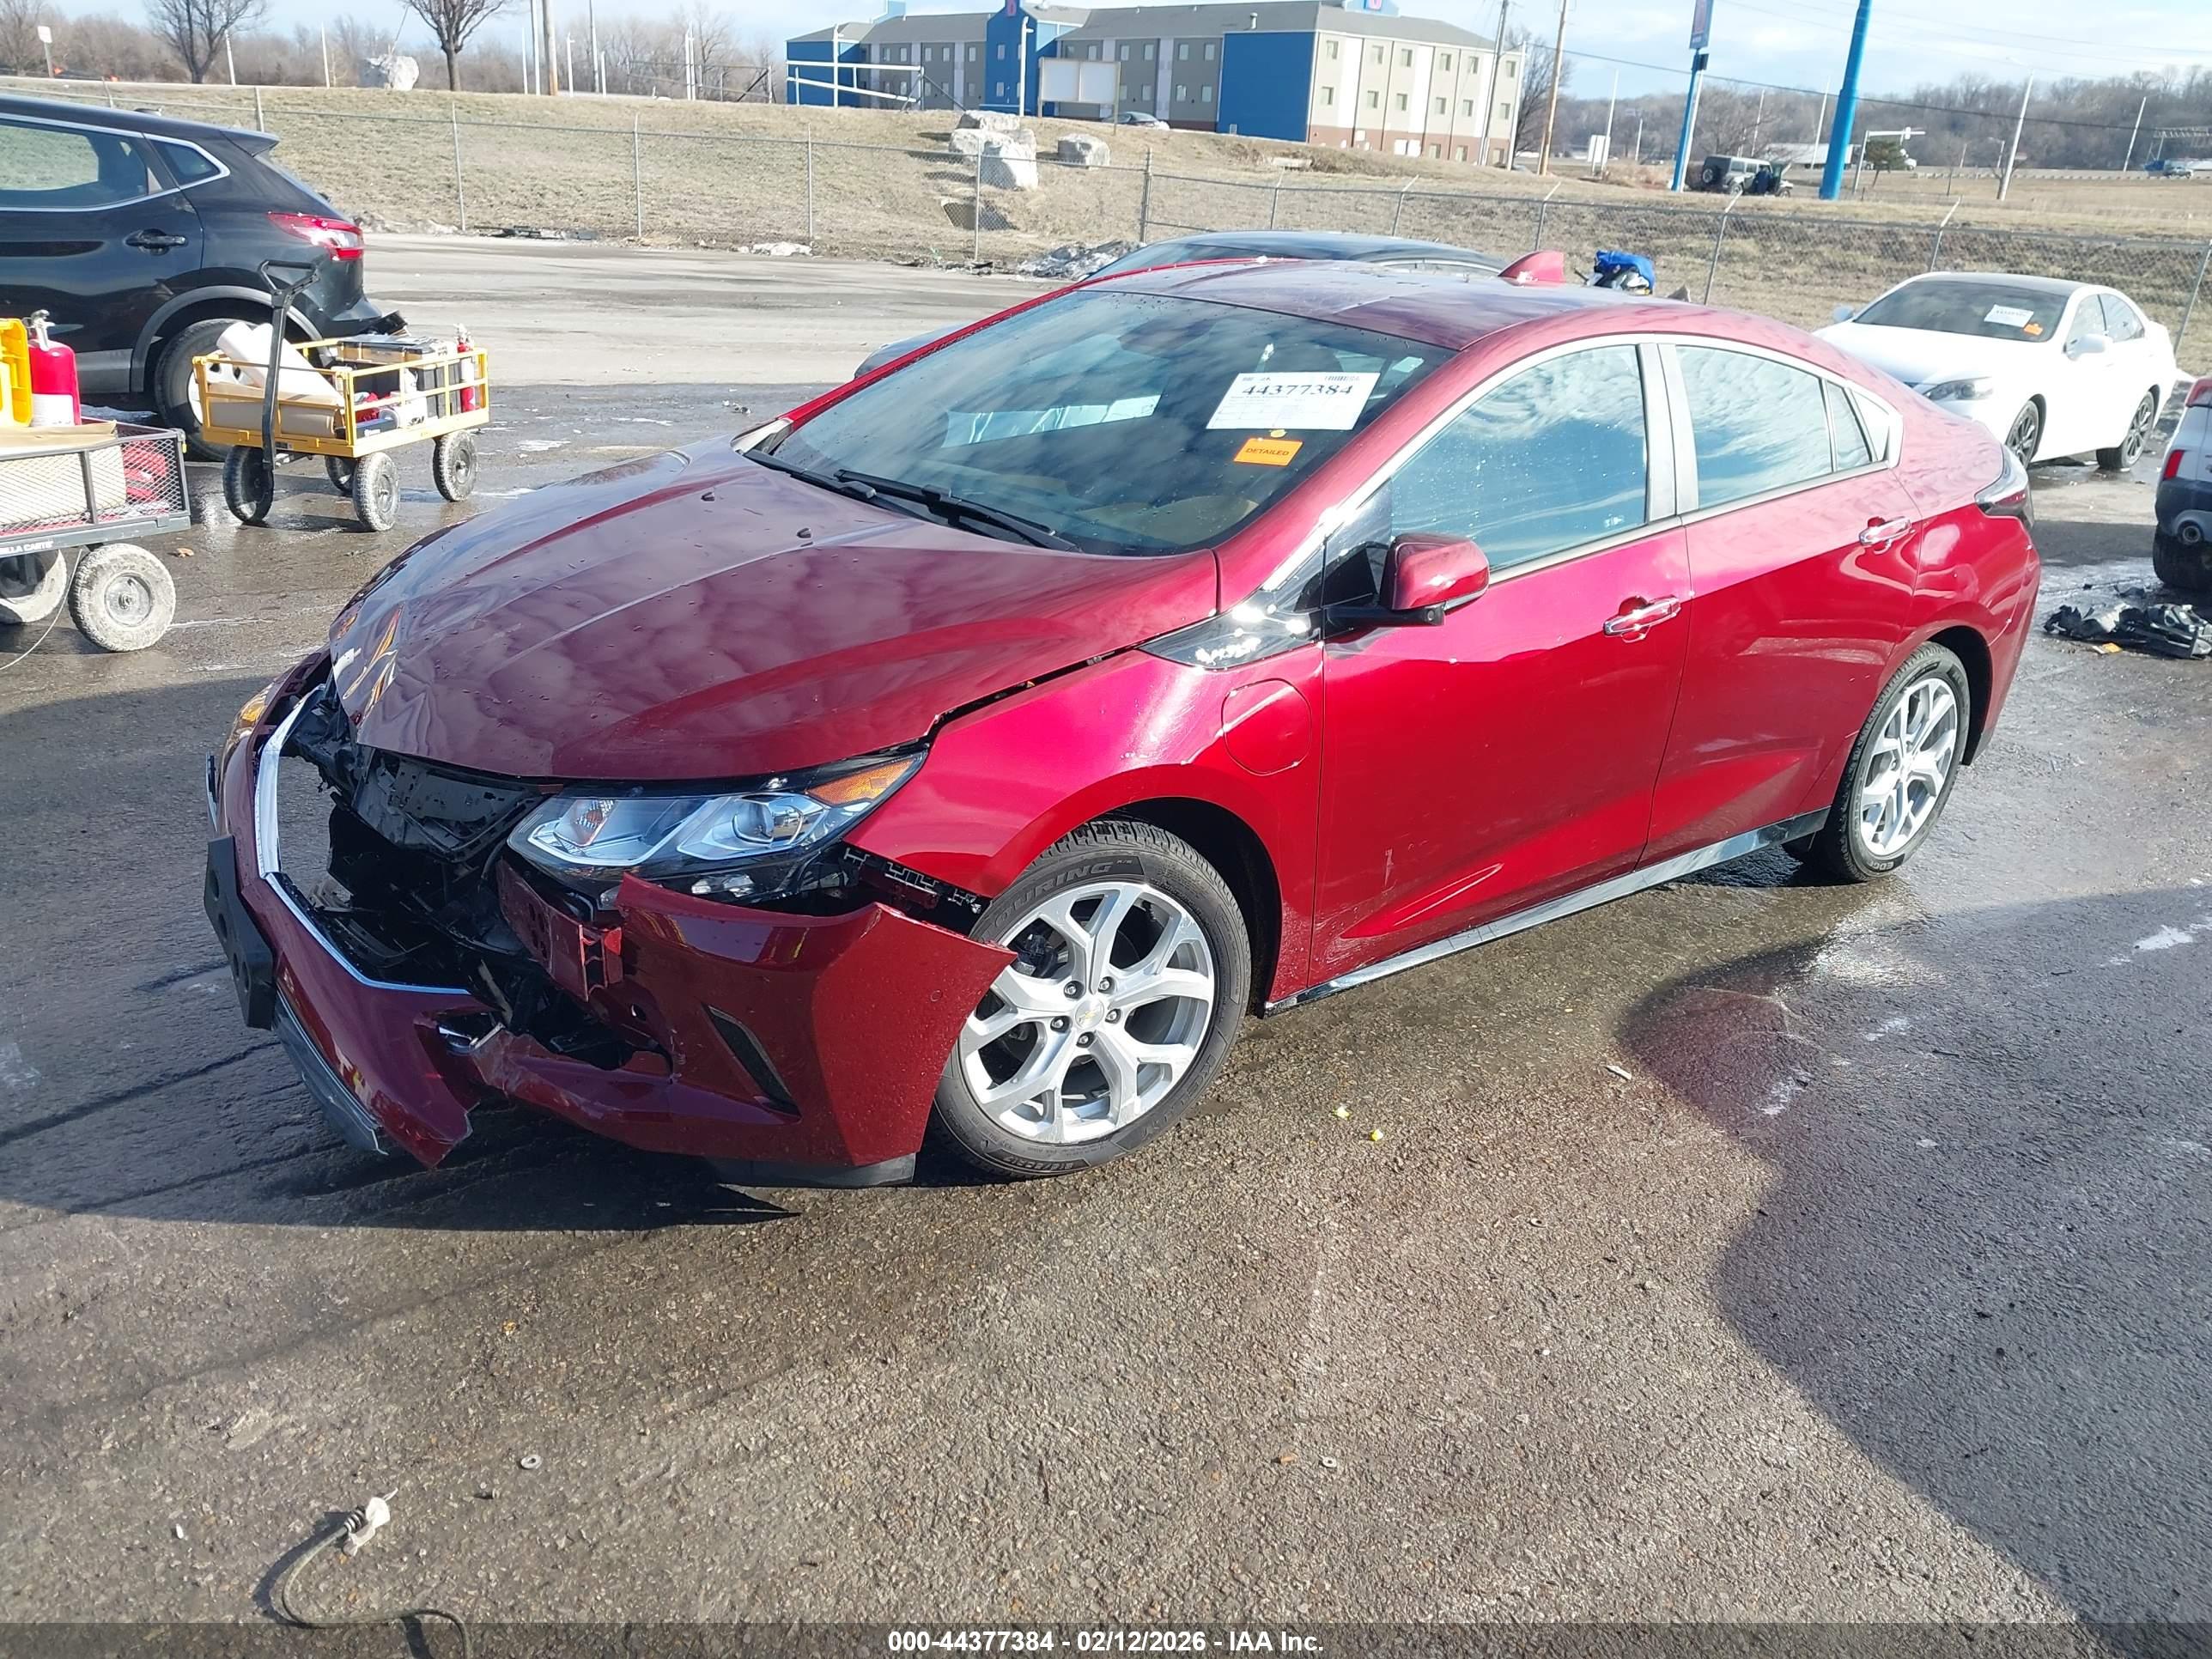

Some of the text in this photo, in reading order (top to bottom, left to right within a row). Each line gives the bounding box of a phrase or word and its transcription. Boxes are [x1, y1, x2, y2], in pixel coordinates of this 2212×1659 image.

[1242, 384, 1353, 395] 44377384
[1245, 447, 1290, 456] DETAILED
[1867, 860, 1894, 871] EDGE
